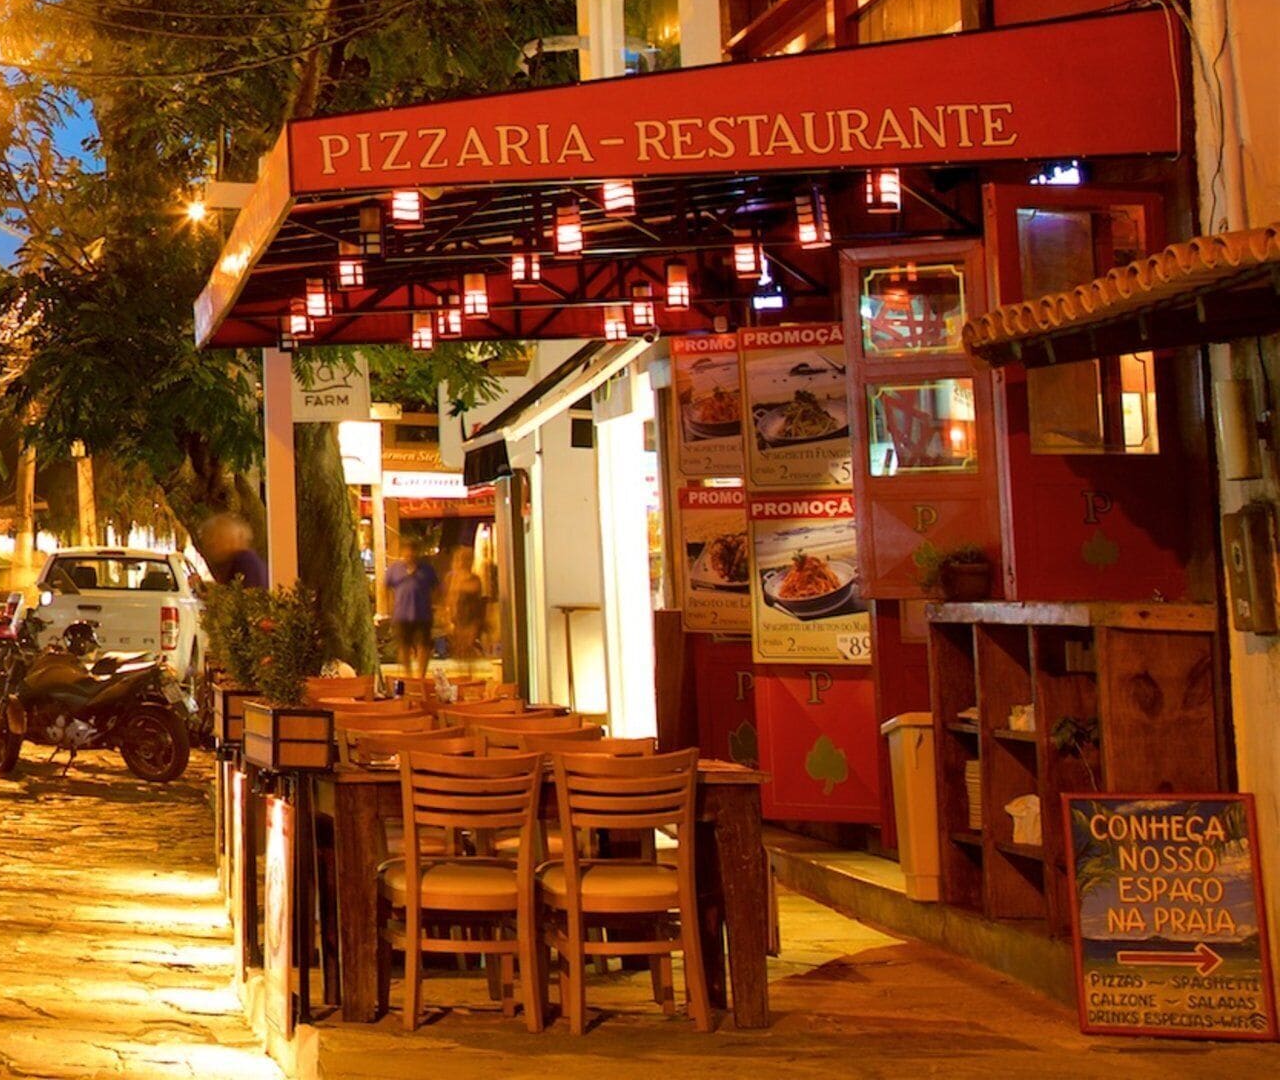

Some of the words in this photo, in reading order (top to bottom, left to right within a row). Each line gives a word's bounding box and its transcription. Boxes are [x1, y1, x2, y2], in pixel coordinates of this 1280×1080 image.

[304, 394, 349, 407] FARM
[787, 637, 796, 652] 2
[1089, 813, 1225, 844] CONHEÇA
[1118, 846, 1216, 873] NOSSO
[1118, 876, 1223, 906] ESPAÇO
[1107, 906, 1146, 934] NA
[1155, 907, 1237, 936] PRAIA
[1090, 973, 1144, 988] PIZZAS
[1171, 974, 1260, 992] SPAGHETTI
[1090, 992, 1157, 1008] CALZONE
[1187, 993, 1257, 1011] SALADAS
[1088, 1009, 1140, 1025] DRINKS
